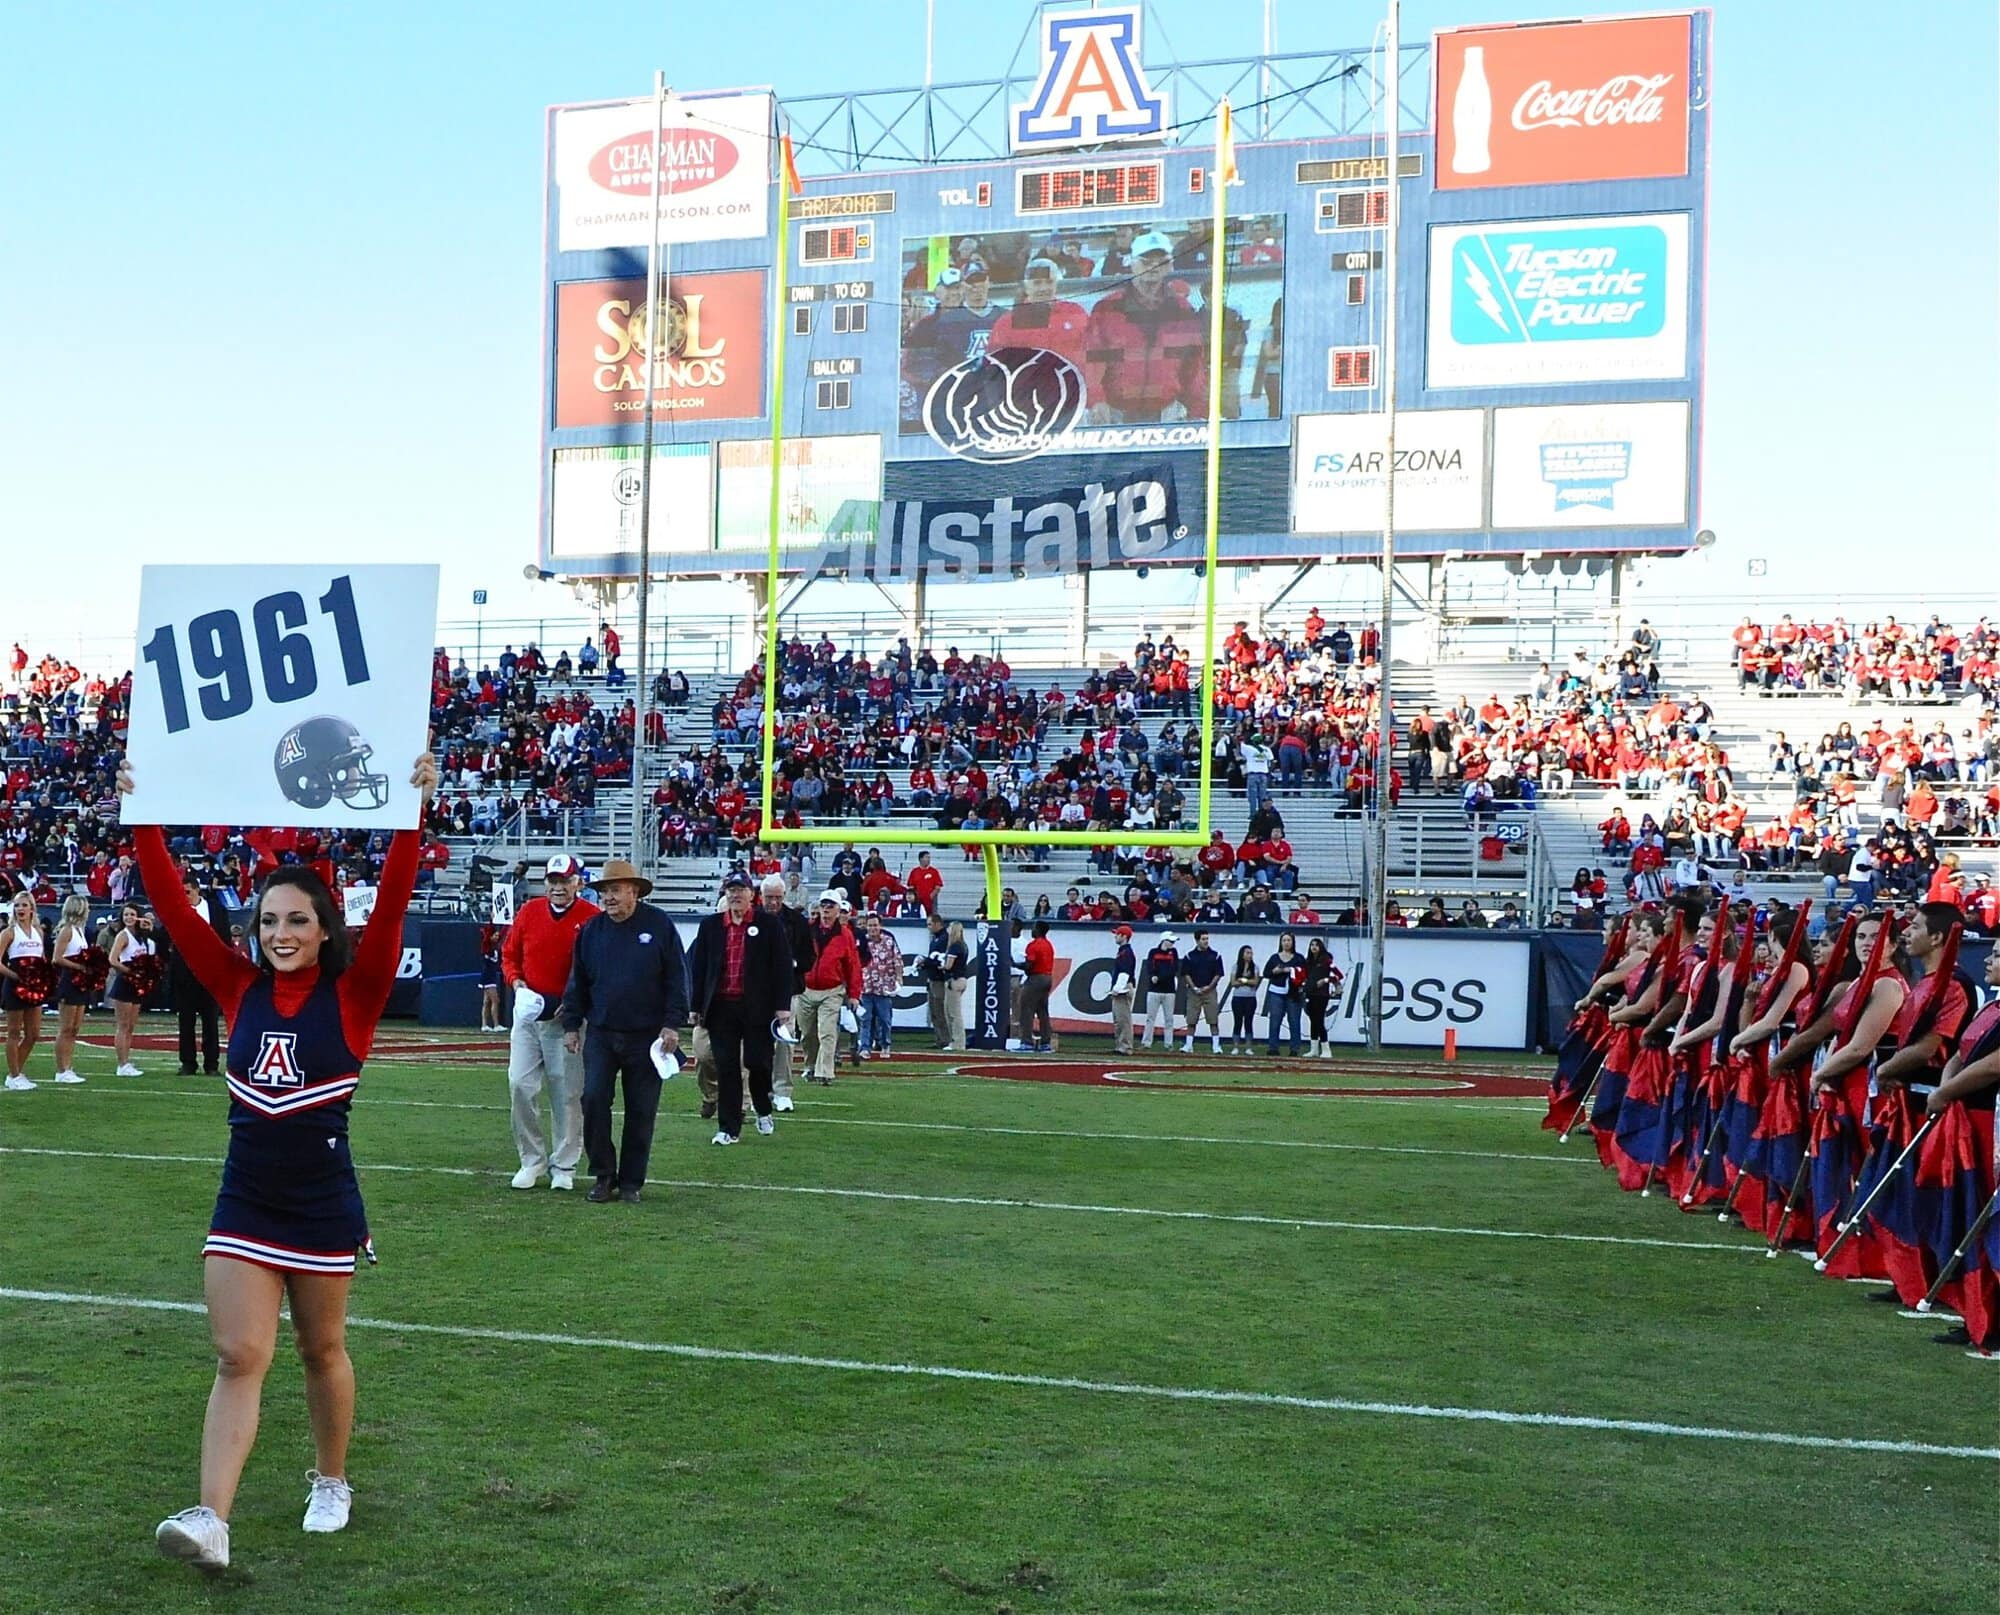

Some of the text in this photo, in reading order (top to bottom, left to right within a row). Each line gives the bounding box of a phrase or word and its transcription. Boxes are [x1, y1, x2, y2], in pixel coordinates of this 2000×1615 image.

[1018, 13, 1162, 142] A
[1511, 72, 1675, 132] Coca-Cola
[608, 138, 717, 172] CHAPMAN
[1208, 169, 1246, 191] TL
[1331, 160, 1385, 179] UTAH
[801, 195, 877, 216] ARIZONA
[938, 188, 974, 207] TOL
[575, 203, 752, 226] CHAPMANUCSON.COM
[831, 227, 854, 258] 0
[1346, 252, 1369, 270] QTR
[1503, 243, 1618, 274] Tucson
[791, 286, 815, 302] DWN
[835, 282, 866, 299] TO GO
[1514, 268, 1648, 299] Electric
[1527, 298, 1646, 328] Power
[593, 358, 727, 393] CASINOS
[813, 359, 855, 376] BALL ON
[613, 397, 705, 411] SOLCAINOS.COM
[1313, 448, 1463, 474] FSARZONA
[802, 481, 1170, 583] Allstate
[475, 591, 486, 603] 27
[142, 575, 371, 734] 1961
[1498, 825, 1522, 839] 29
[984, 937, 1000, 1038] ARIZONA
[248, 1031, 305, 1089] A
